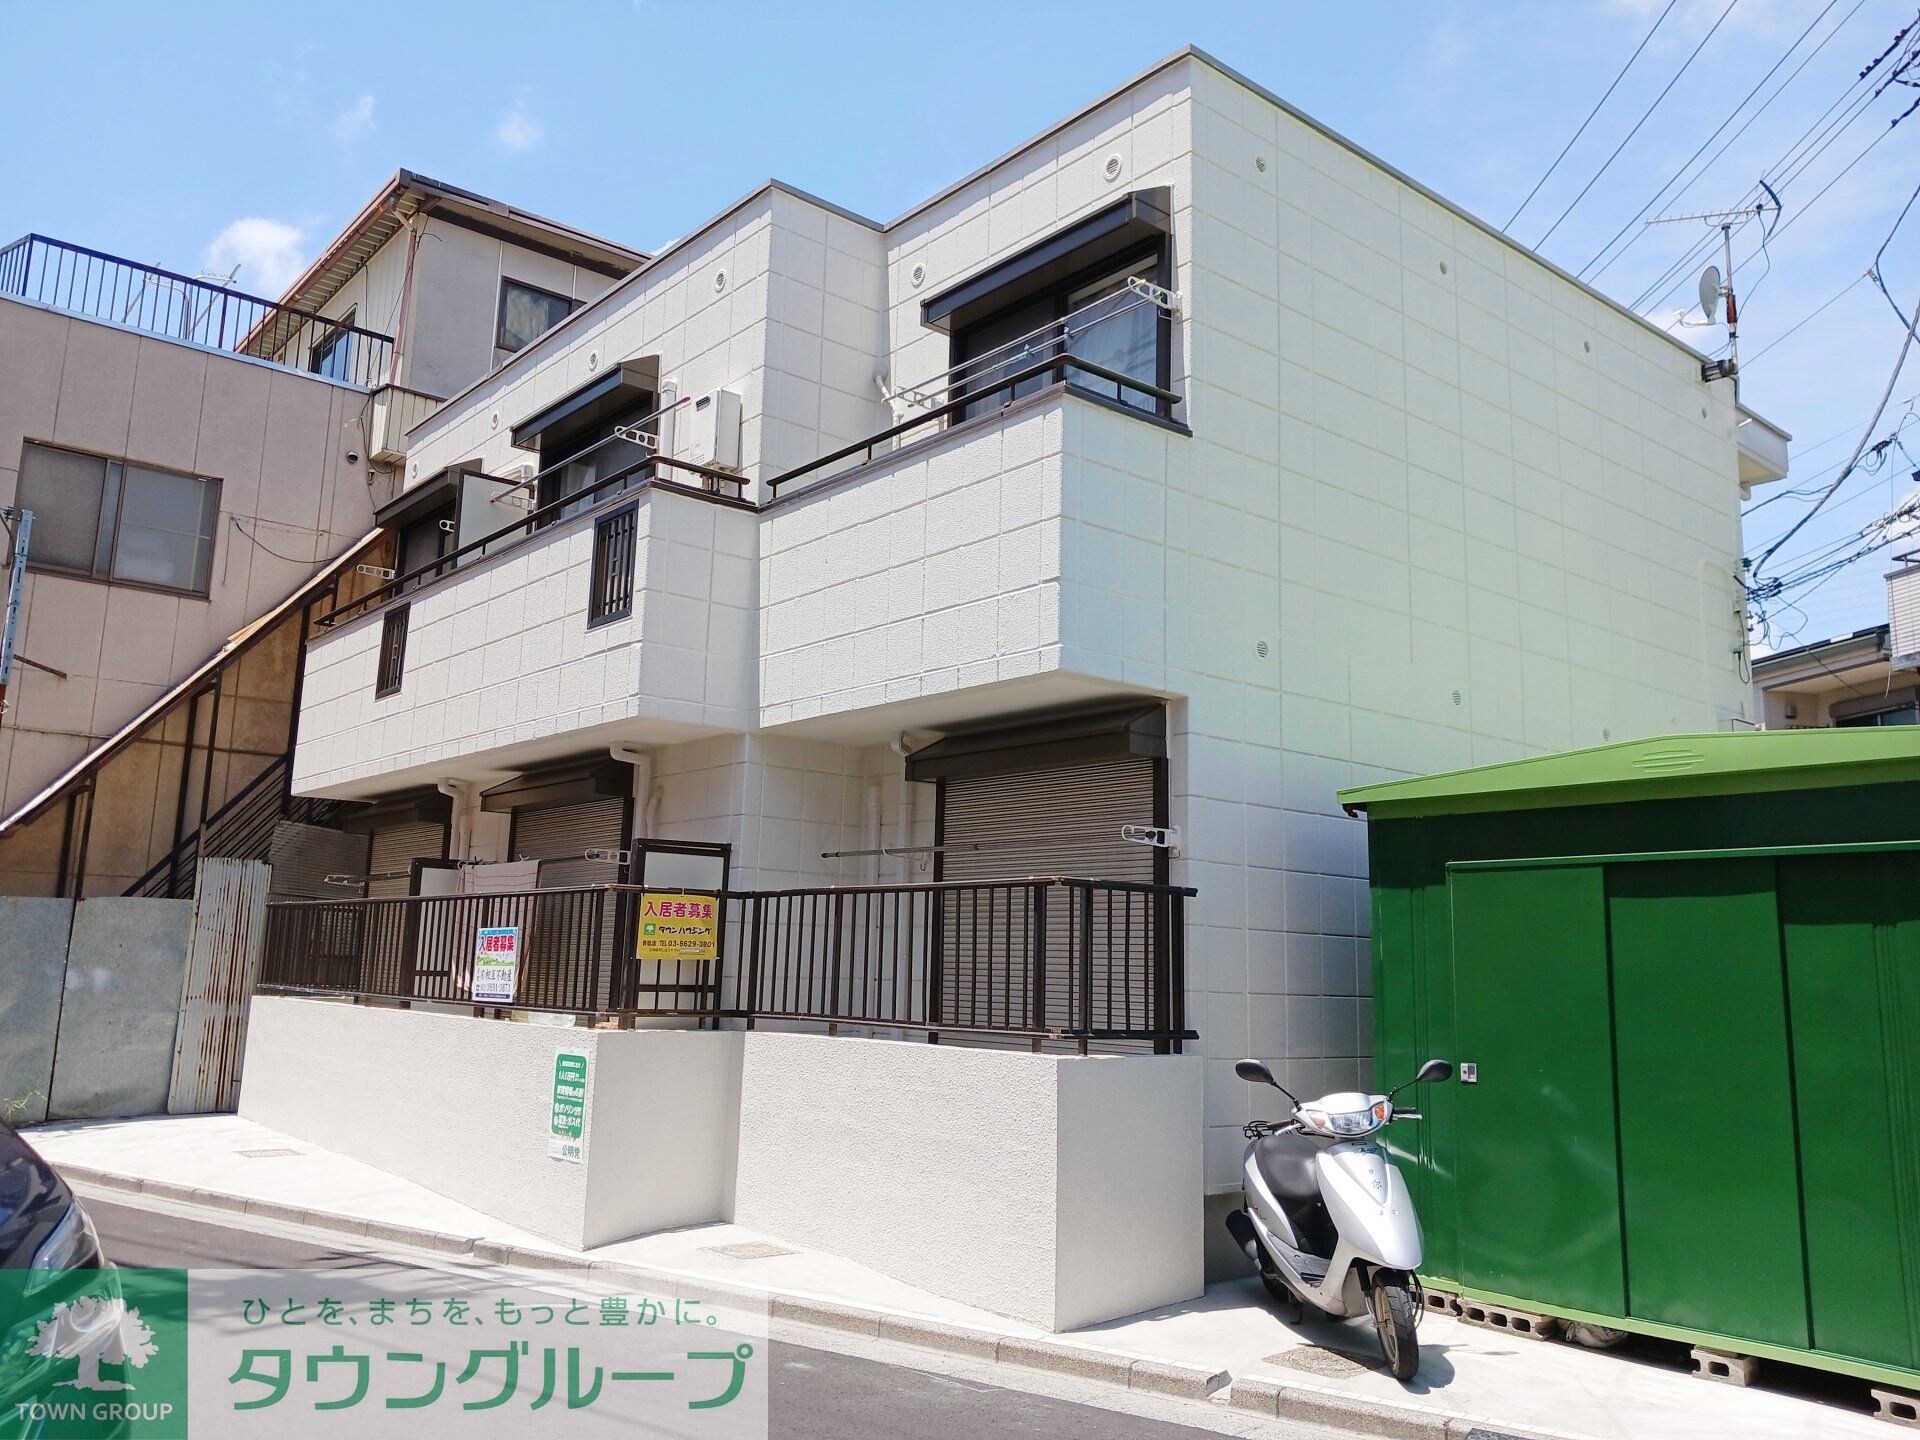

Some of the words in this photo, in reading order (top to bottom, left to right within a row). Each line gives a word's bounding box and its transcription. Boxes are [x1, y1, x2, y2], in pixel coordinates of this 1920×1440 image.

[643, 900, 713, 920] 入居者募集
[658, 925, 712, 936] タウンハウジング
[478, 934, 515, 952] 入居者募集
[561, 1144, 581, 1159] 公明党
